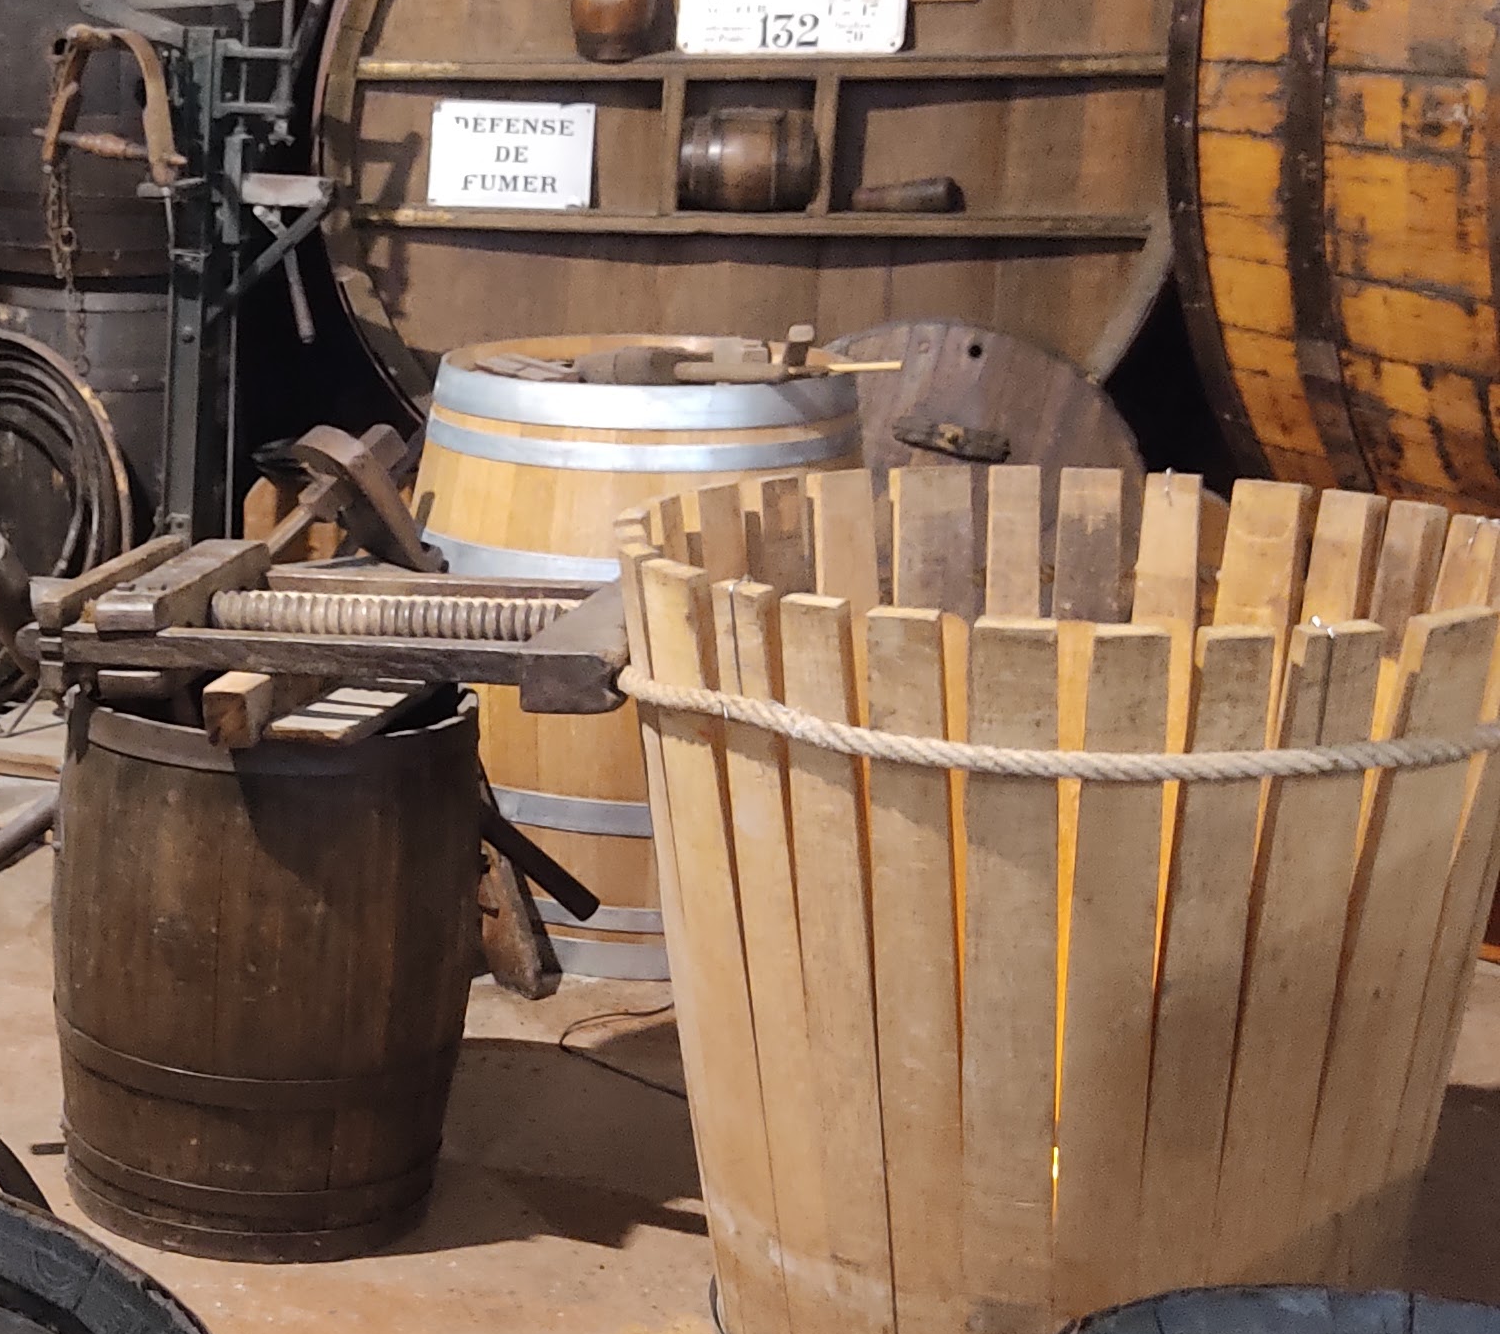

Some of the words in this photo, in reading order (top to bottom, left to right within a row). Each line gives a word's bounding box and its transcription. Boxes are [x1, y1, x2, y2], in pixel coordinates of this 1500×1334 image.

[757, 13, 820, 48] 132
[494, 145, 529, 164] DE
[460, 173, 558, 194] FUMER
